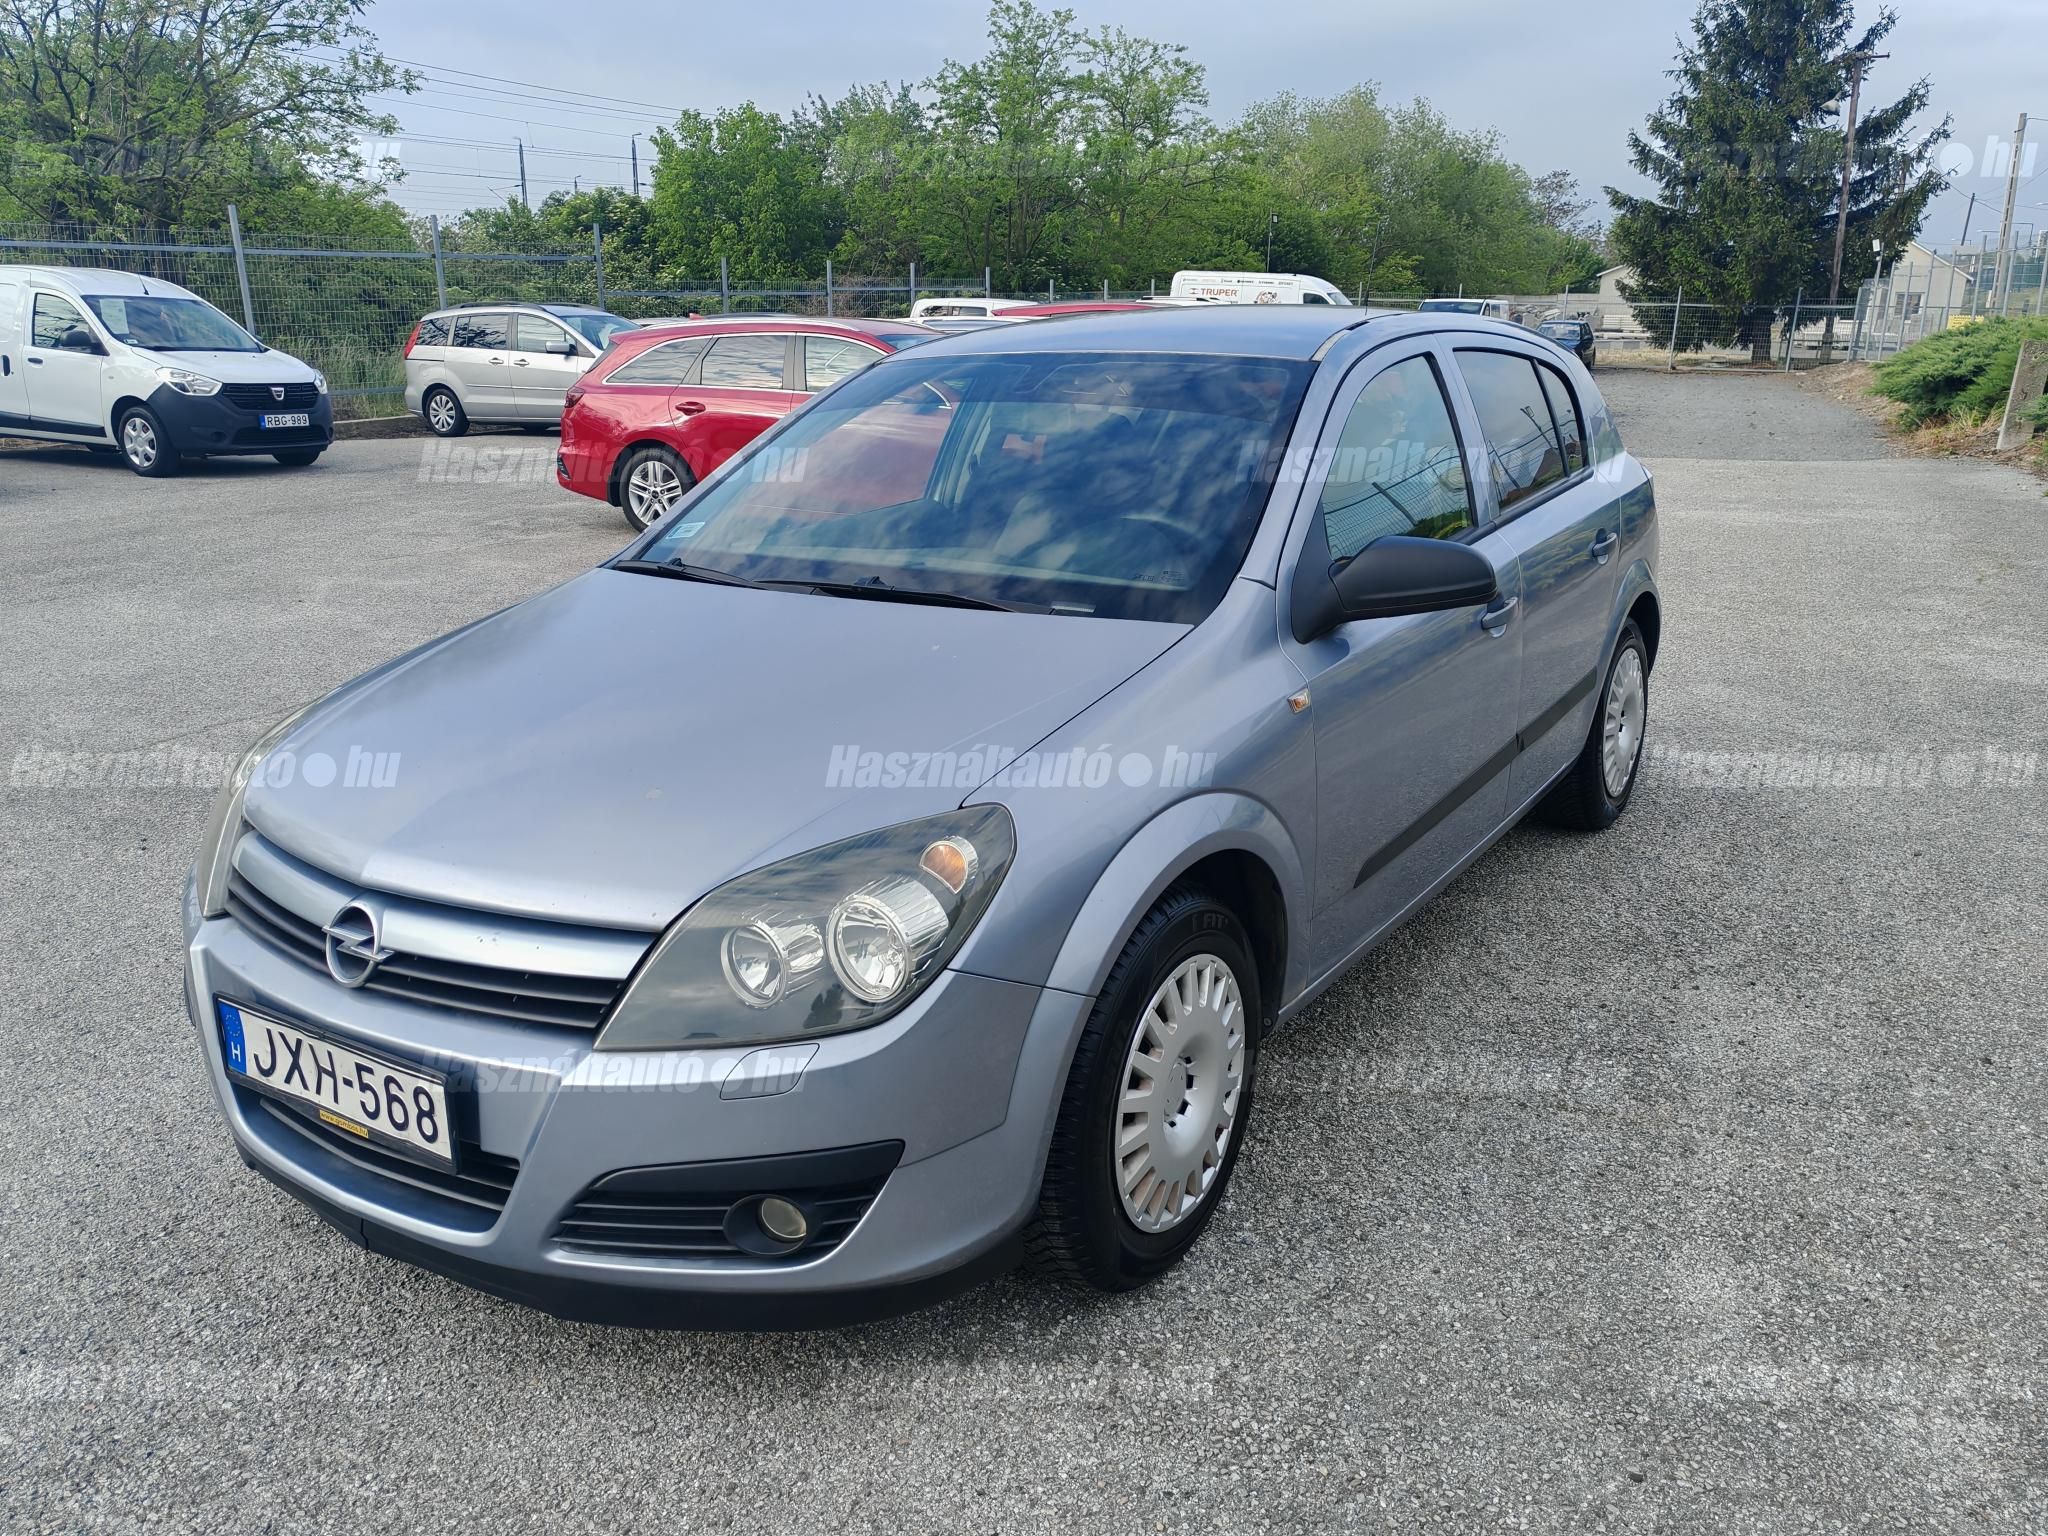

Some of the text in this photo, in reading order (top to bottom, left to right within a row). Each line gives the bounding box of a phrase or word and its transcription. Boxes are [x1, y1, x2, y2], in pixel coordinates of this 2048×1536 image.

[1200, 287, 1238, 297] TRUPER
[266, 415, 308, 426] RBG-989
[231, 1041, 241, 1062] H
[253, 1027, 439, 1144] JXH-568
